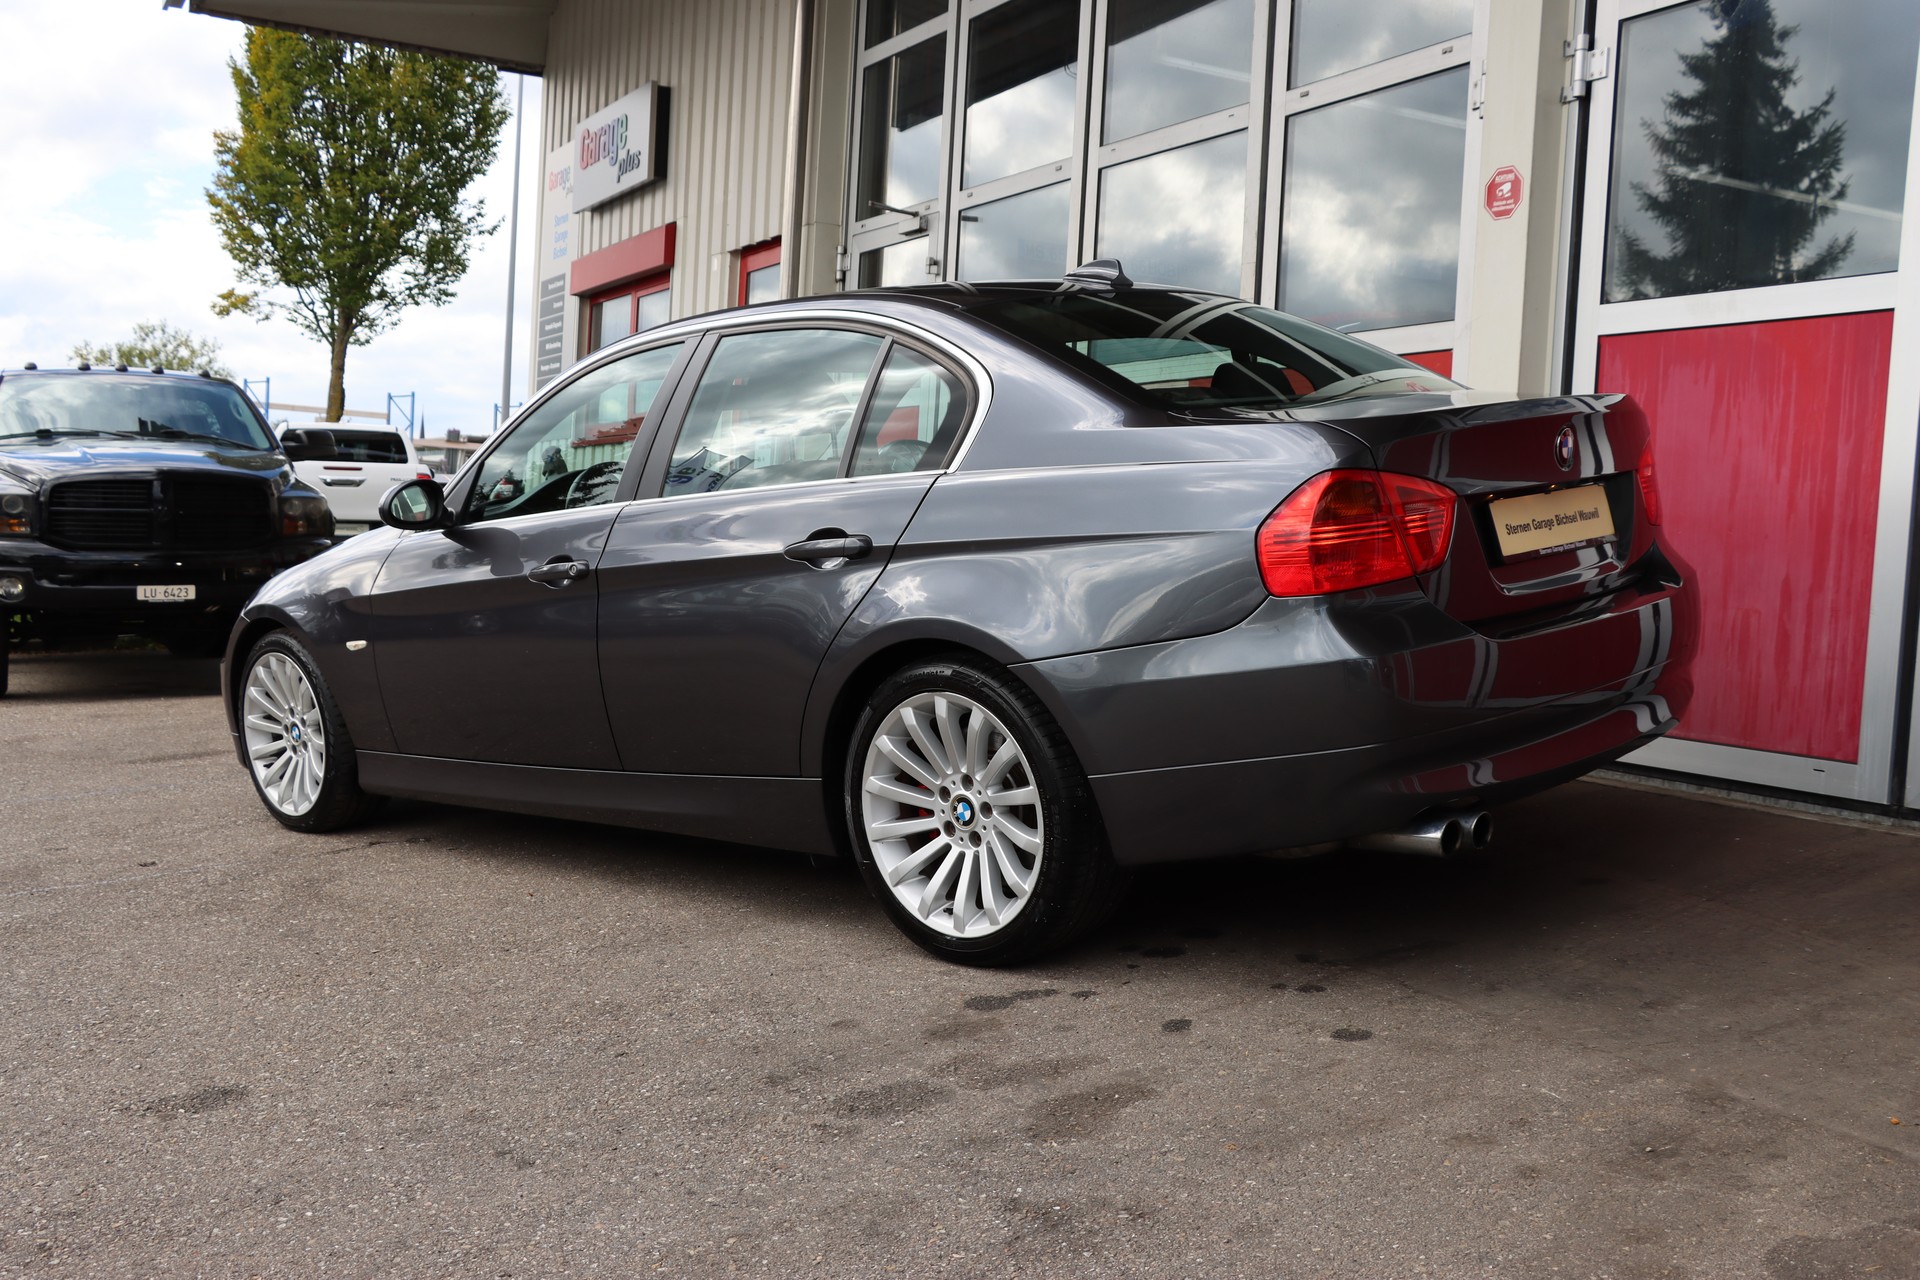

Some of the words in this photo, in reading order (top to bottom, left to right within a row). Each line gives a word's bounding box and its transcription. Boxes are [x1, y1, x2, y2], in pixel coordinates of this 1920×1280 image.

[579, 113, 628, 170] Garage
[616, 148, 641, 184] plus
[1505, 521, 1532, 535] Sternen
[1531, 518, 1555, 531] Garage
[1555, 510, 1578, 526] Bichsel
[143, 587, 157, 598] LU
[163, 587, 189, 598] 6423
